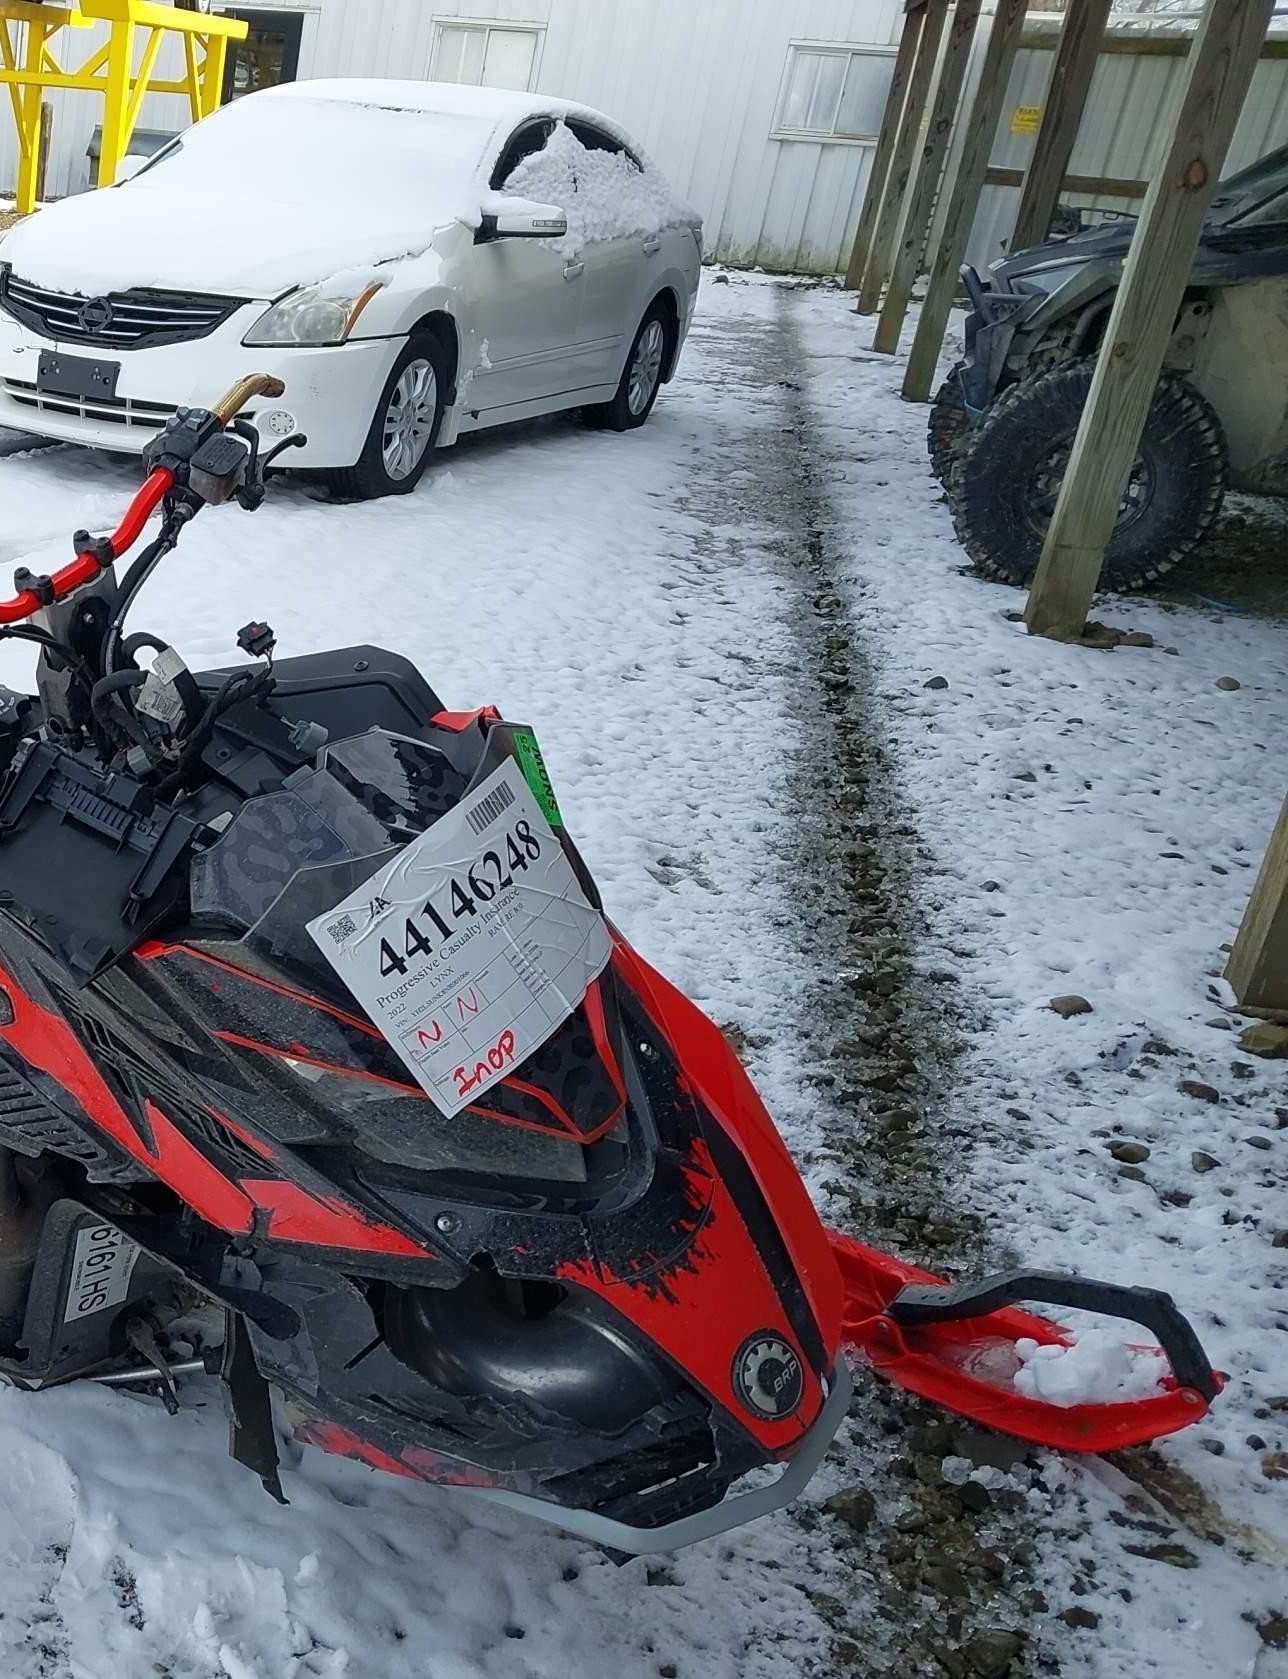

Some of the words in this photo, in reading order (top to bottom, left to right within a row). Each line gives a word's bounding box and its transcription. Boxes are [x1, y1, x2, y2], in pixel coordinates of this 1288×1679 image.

[519, 734, 532, 753] 25
[531, 747, 558, 812] SNOW
[378, 819, 541, 979] 44146248
[376, 958, 440, 1008] Progressive
[438, 921, 480, 961] Casualty
[480, 887, 520, 923] Insurance
[386, 1002, 407, 1019] 2022
[429, 965, 454, 988] LYNX
[418, 1019, 440, 1049] N
[457, 987, 477, 1021] N
[774, 1360, 797, 1393] BRP
